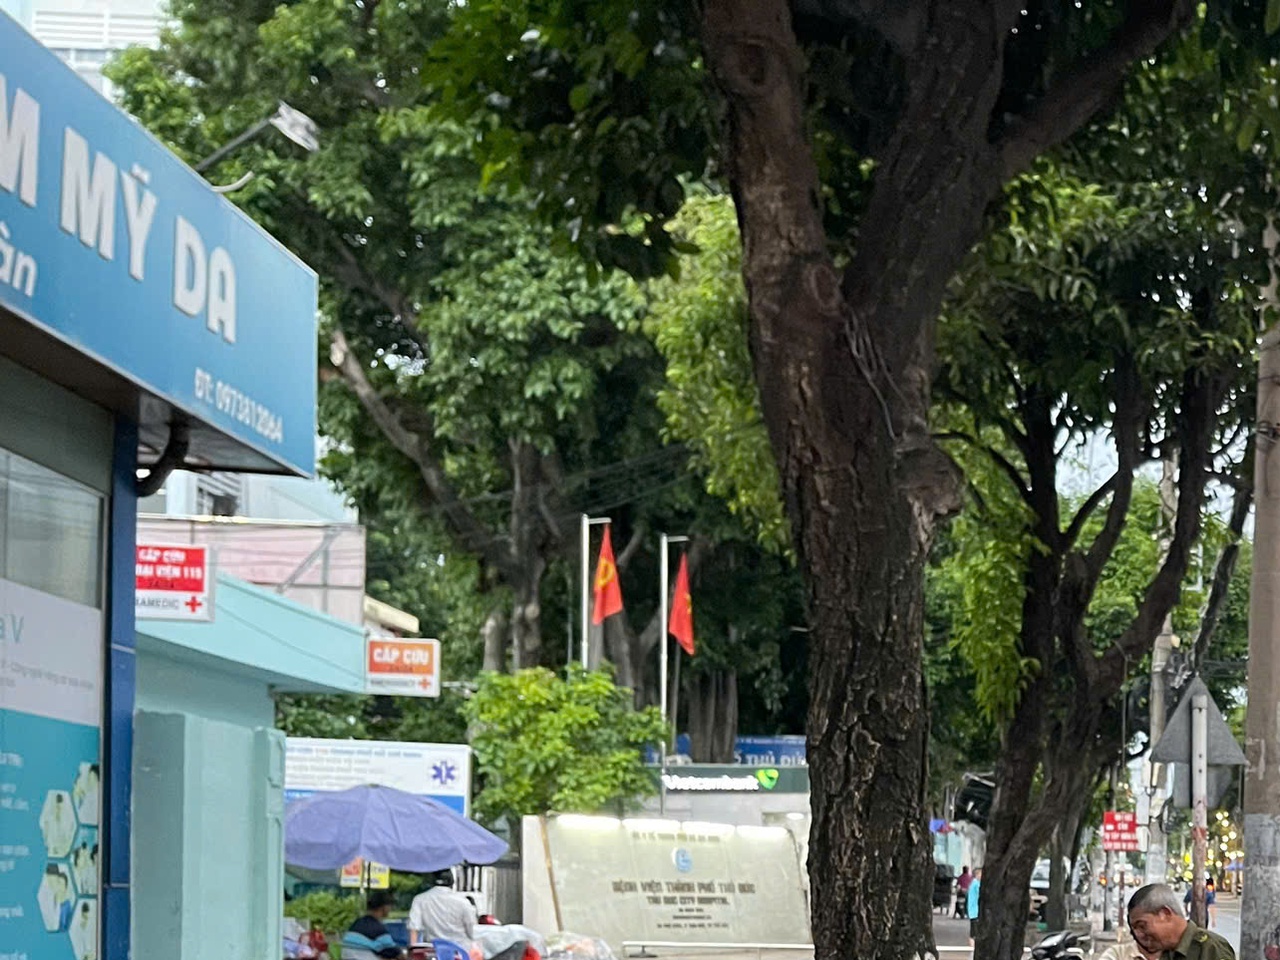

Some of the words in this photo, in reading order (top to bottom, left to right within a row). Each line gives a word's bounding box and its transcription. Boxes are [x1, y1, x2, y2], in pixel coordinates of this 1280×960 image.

[60, 125, 158, 282] MỸ
[172, 215, 238, 345] DA
[661, 774, 760, 790] Vietcombank
